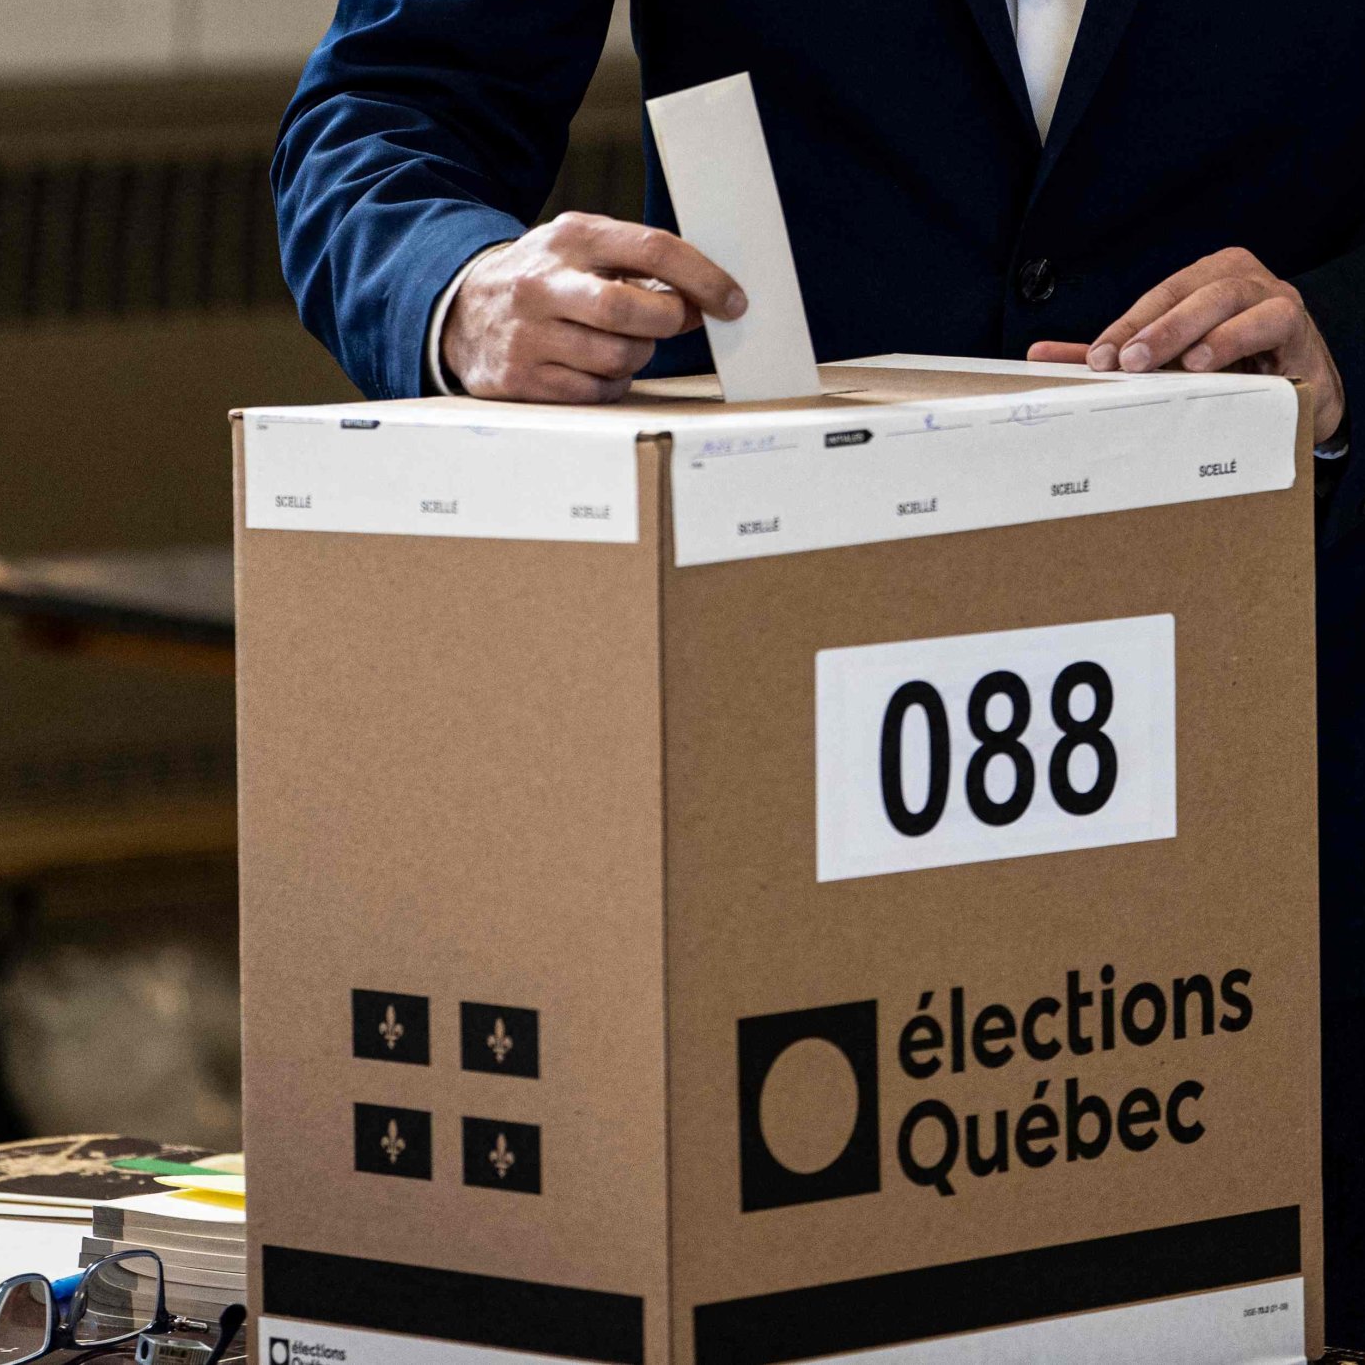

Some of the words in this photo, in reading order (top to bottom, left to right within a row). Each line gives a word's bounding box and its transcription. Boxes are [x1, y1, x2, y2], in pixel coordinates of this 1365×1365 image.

[1198, 458, 1237, 478] SCELLÉ
[1050, 478, 1089, 497] SCELLÉ
[275, 493, 312, 509] SCELLÉ
[419, 498, 458, 514] SCELLÉ
[896, 498, 938, 516] SCELLÉ
[570, 504, 611, 520] SCELLÉ
[736, 516, 780, 536] SCELLÉ
[879, 660, 1119, 838] 088
[897, 963, 1255, 1080] élections
[896, 1078, 1206, 1197] Québec
[292, 1340, 347, 1361] élections
